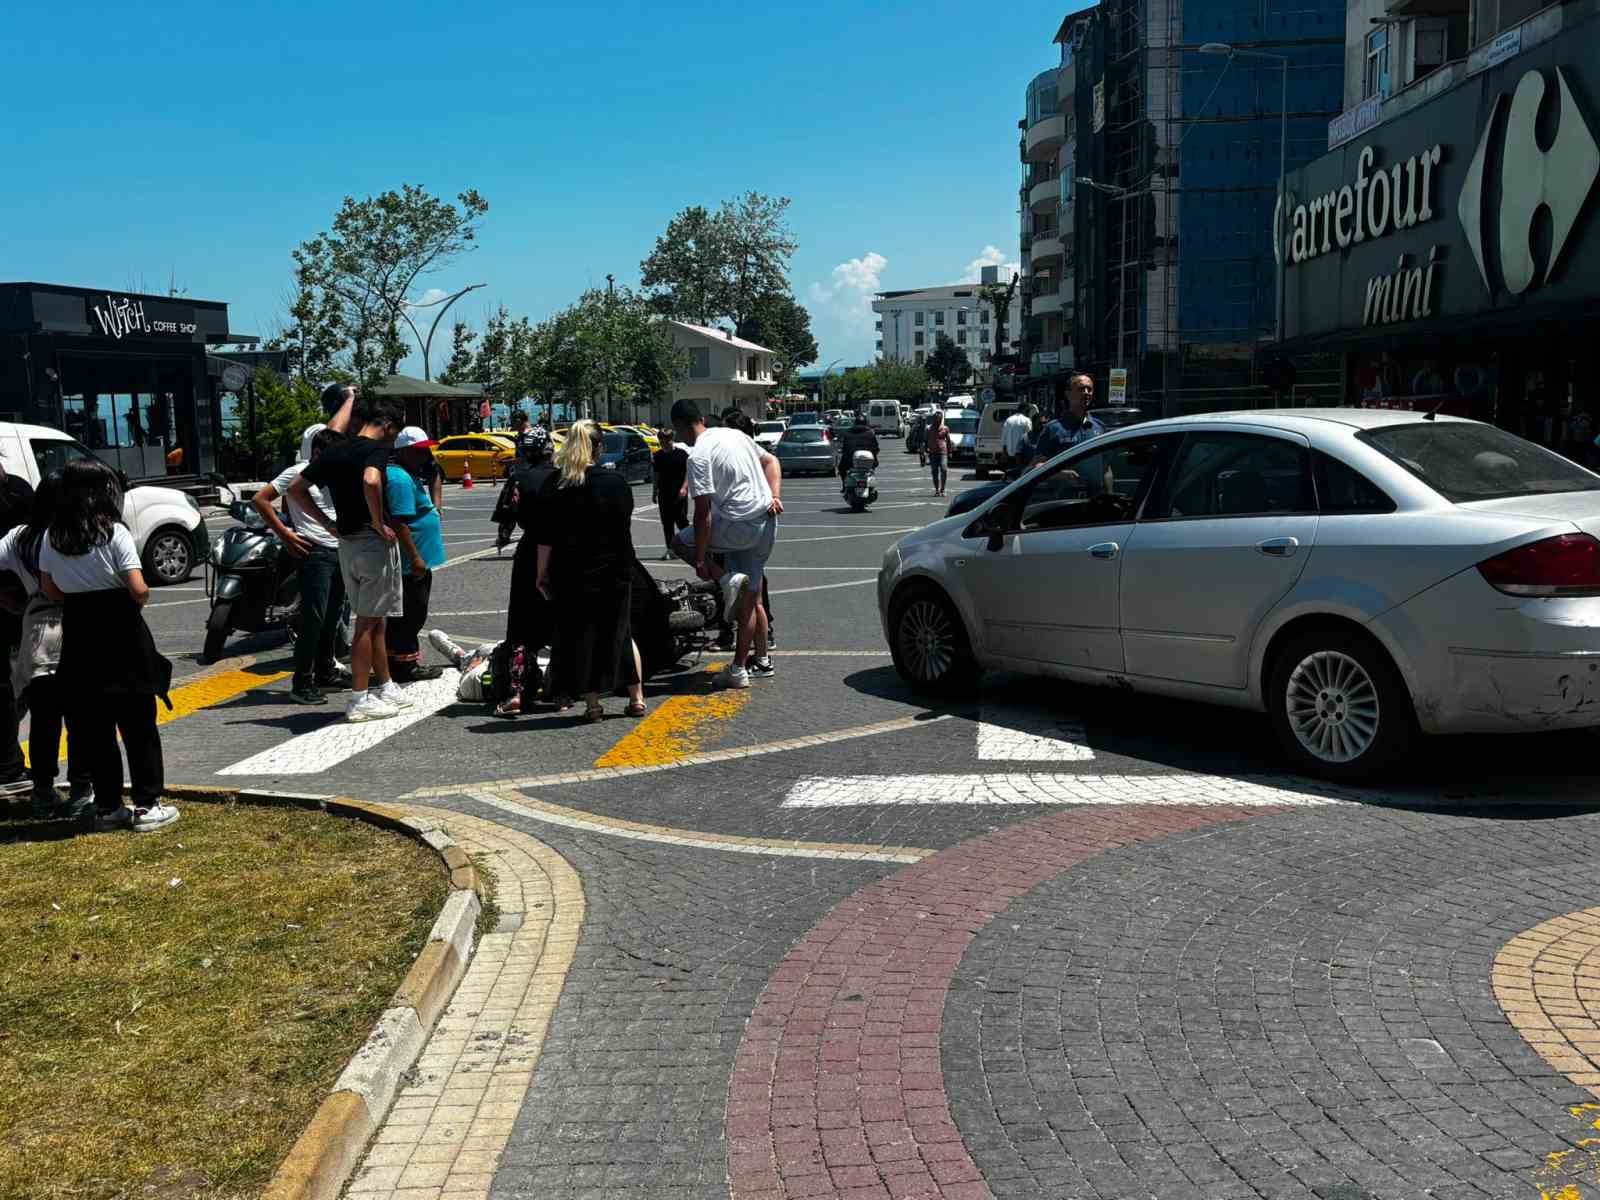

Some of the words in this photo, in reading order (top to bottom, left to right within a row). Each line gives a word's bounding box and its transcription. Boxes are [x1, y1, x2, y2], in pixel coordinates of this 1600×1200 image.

[1363, 245, 1436, 326] mini
[153, 320, 177, 333] COFFEE
[179, 323, 197, 334] SHOP
